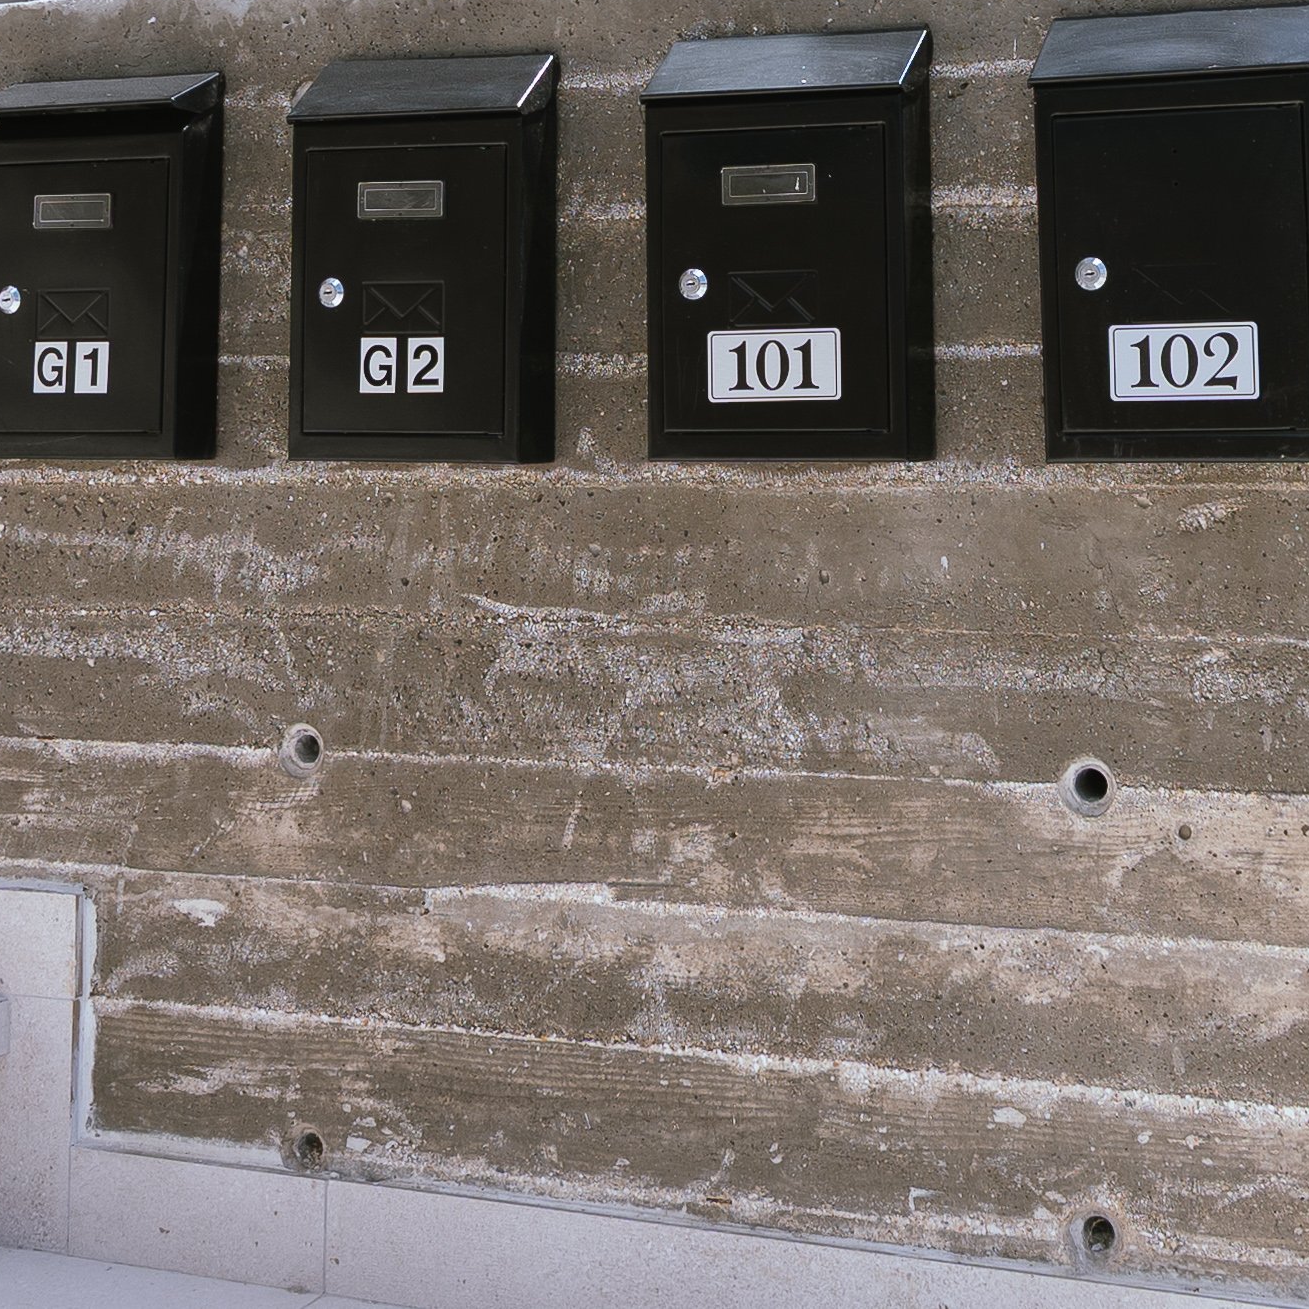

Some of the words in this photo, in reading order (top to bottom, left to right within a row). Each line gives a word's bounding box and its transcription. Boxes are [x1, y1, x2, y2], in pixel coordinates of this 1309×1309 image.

[37, 346, 99, 387] G1
[363, 344, 439, 387] G2
[729, 339, 819, 391] 101
[1130, 332, 1239, 390] 102
